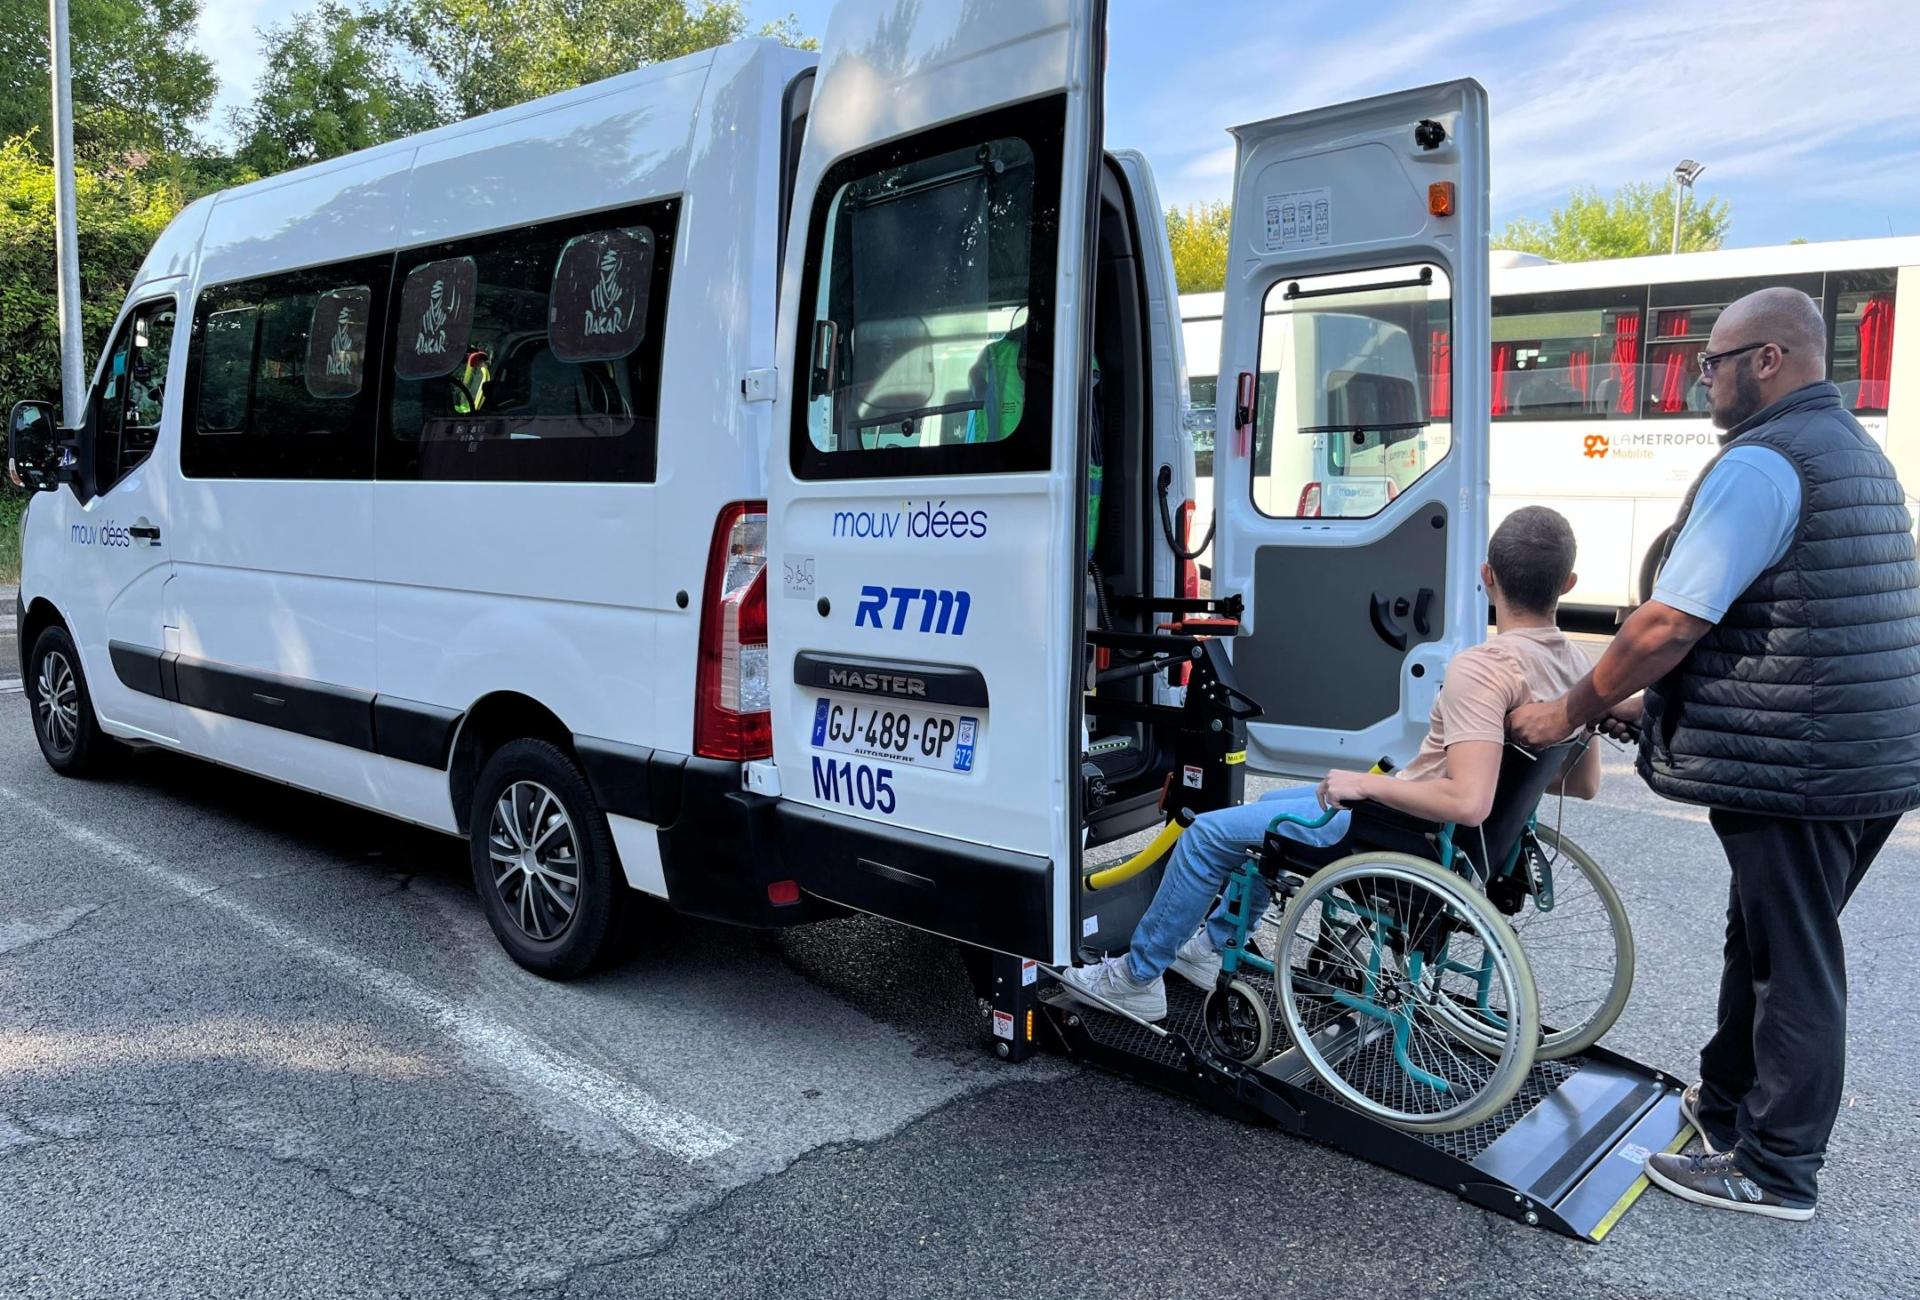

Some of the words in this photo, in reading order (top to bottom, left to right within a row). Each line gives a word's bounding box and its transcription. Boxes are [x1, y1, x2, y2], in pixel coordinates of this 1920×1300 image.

[584, 307, 623, 336] DAKAR
[415, 330, 447, 356] DAKAR
[1612, 433, 1716, 446] LAMETROPOL
[854, 585, 971, 636] RTM
[828, 668, 927, 697] MASTER
[828, 704, 955, 759] GJ-489-GP
[955, 748, 972, 767] 972
[811, 755, 896, 815] M105
